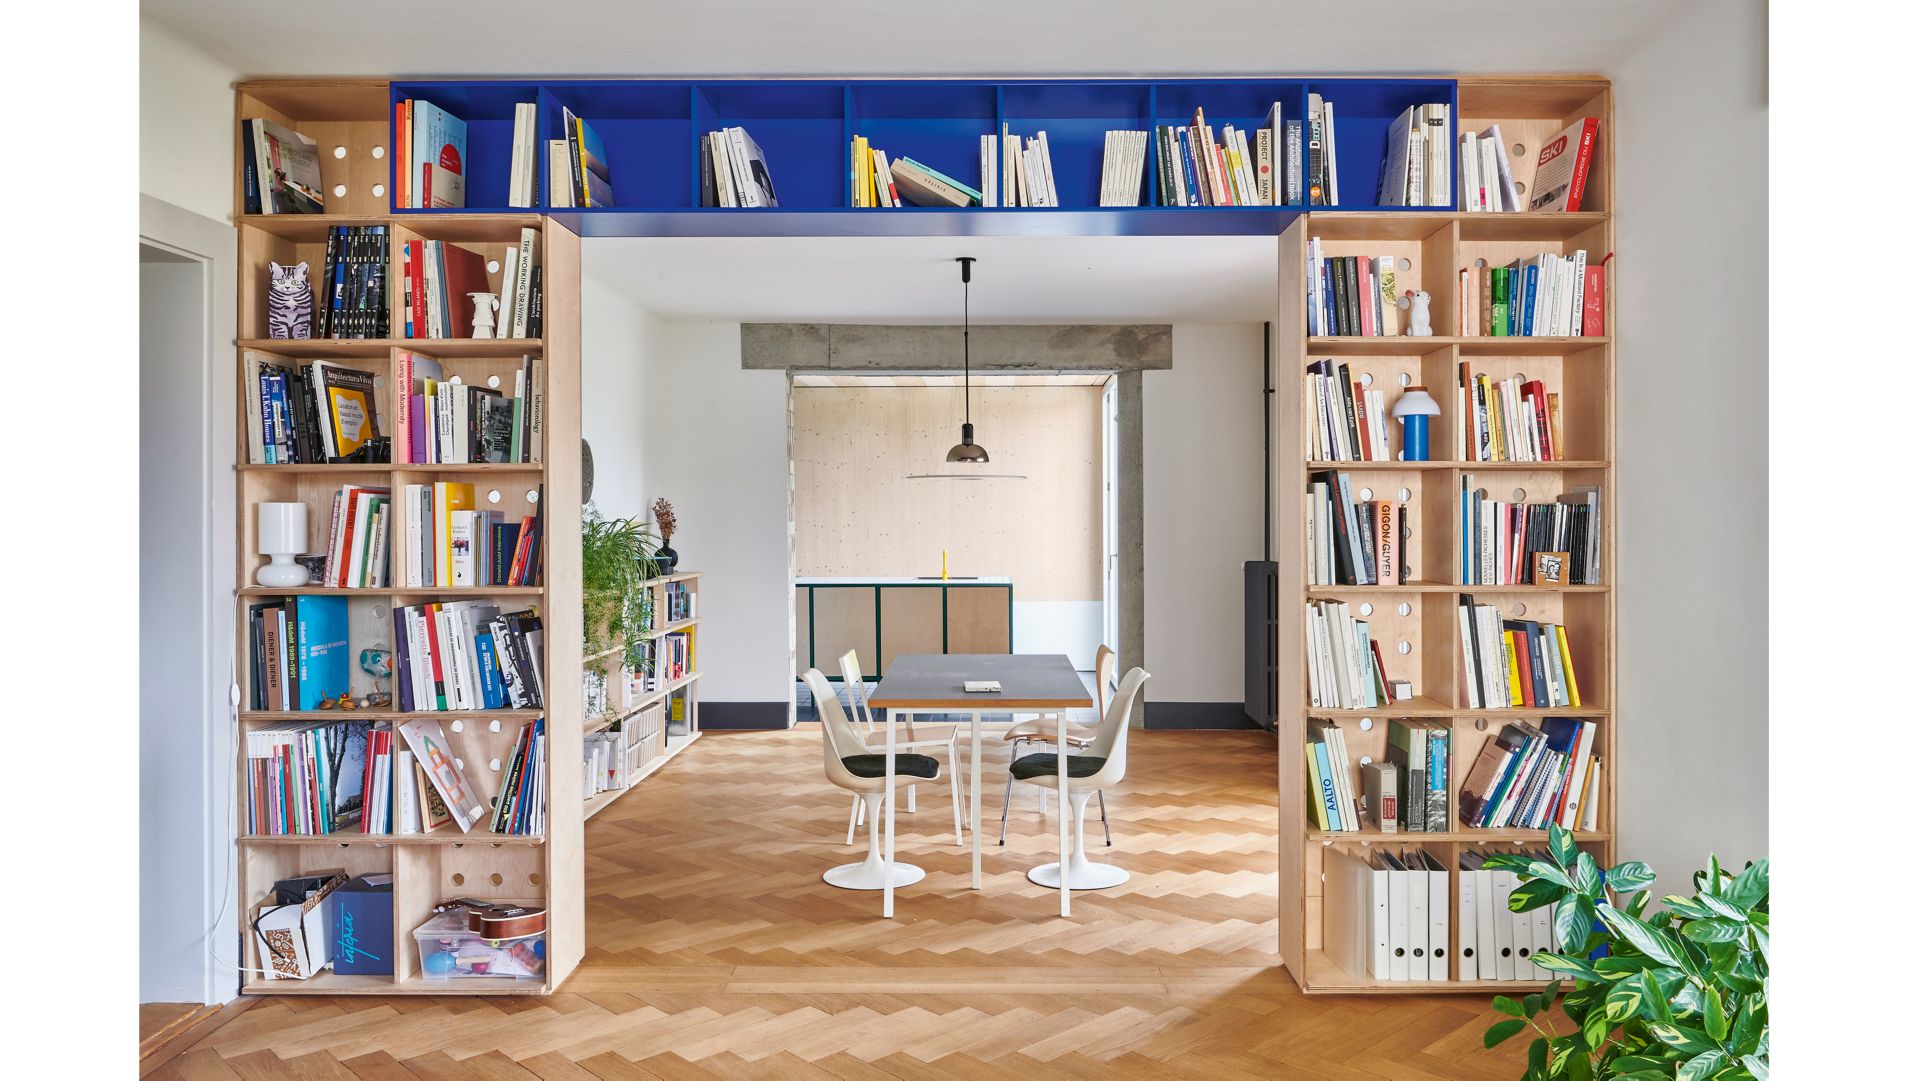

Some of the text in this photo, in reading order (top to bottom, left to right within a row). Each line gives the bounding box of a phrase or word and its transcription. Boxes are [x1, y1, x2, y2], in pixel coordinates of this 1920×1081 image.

[1583, 132, 1591, 145] SKI
[1539, 140, 1565, 165] SKI
[1261, 179, 1269, 200] JAPAN
[516, 240, 530, 327] THE WORKING DRAWING
[1575, 294, 1583, 314] Factory
[398, 360, 406, 378] Living
[260, 376, 268, 395] Louis
[263, 400, 271, 418] Kahn
[398, 393, 407, 425] Modernity
[533, 394, 542, 434] behaviorology
[264, 418, 272, 443] Houses
[1381, 504, 1391, 577] GIGON/GUYER
[267, 631, 275, 656] DIENER
[418, 620, 428, 656] Pierrette
[269, 663, 277, 689] DIENER
[1322, 778, 1337, 811] AALTO
